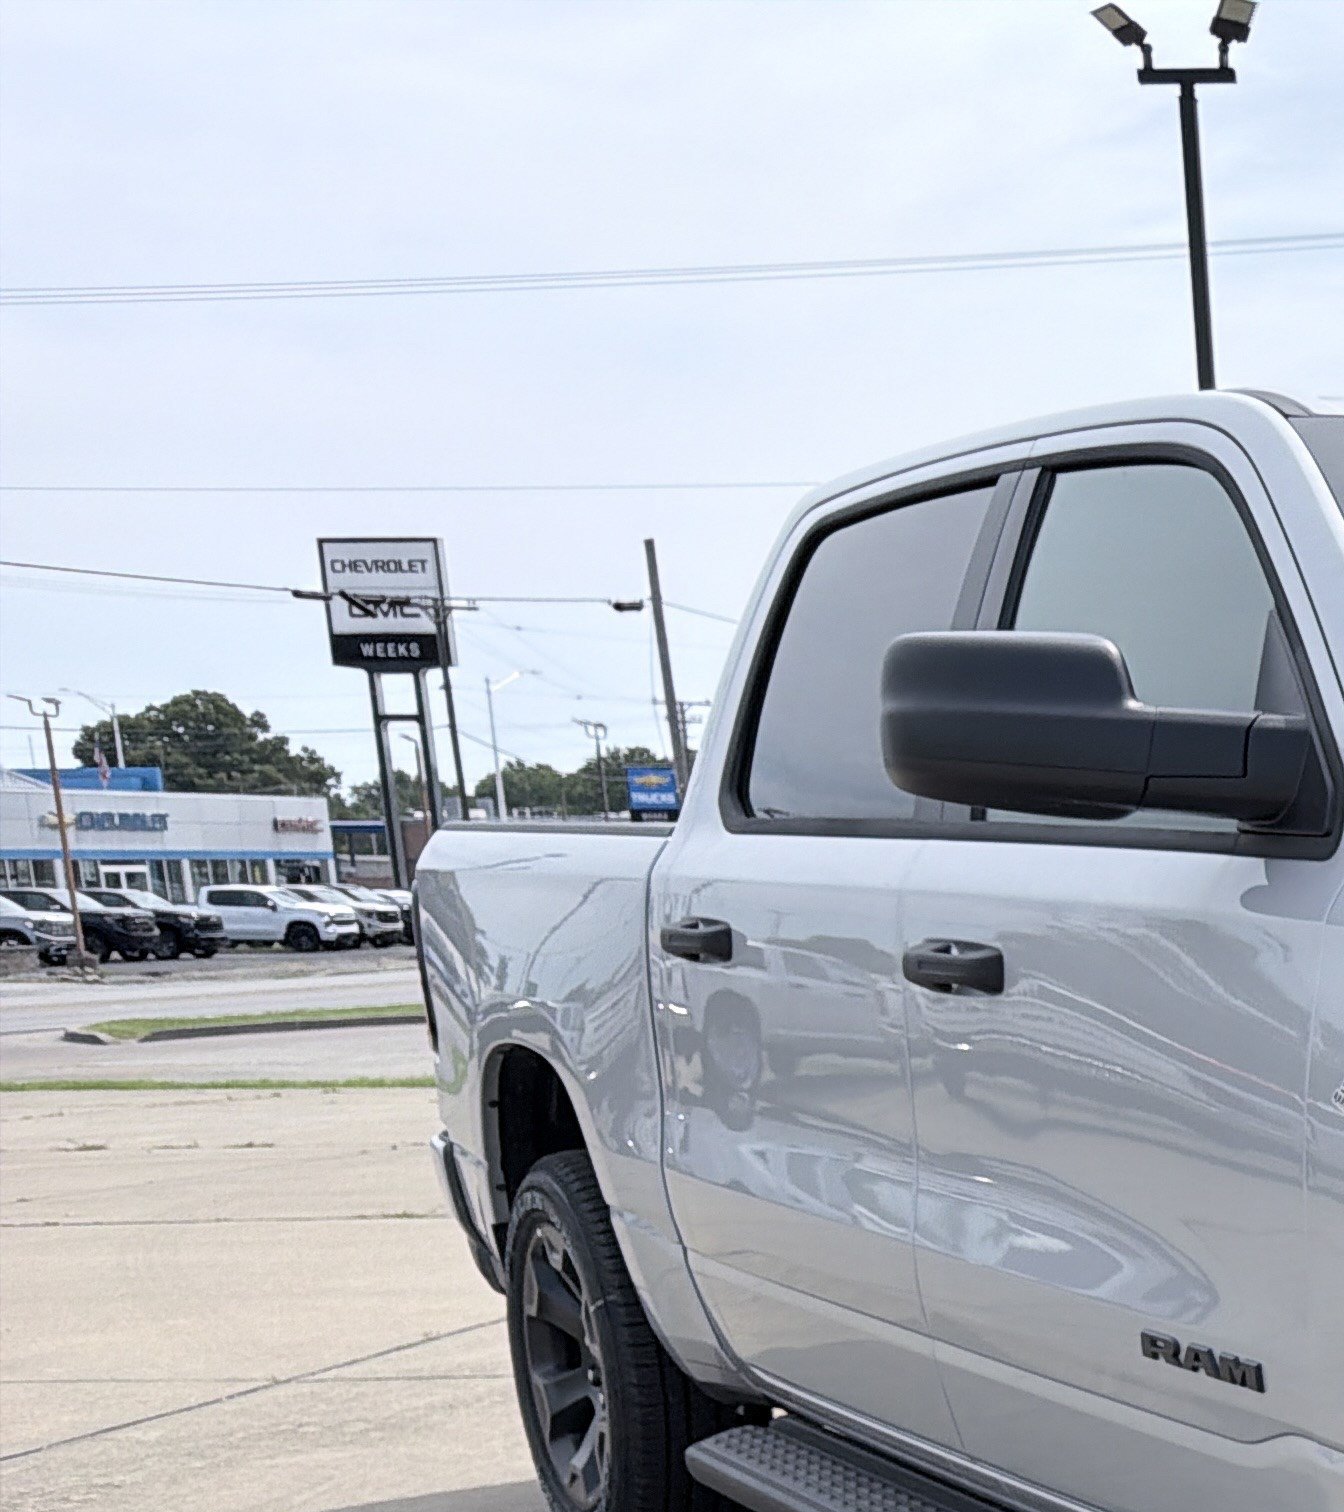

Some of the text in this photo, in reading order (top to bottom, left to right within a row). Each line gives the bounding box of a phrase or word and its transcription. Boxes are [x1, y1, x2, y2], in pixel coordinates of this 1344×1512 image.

[330, 559, 428, 574] CHEVROLET
[360, 642, 420, 658] WEEKS
[1140, 1328, 1266, 1394] RAM
